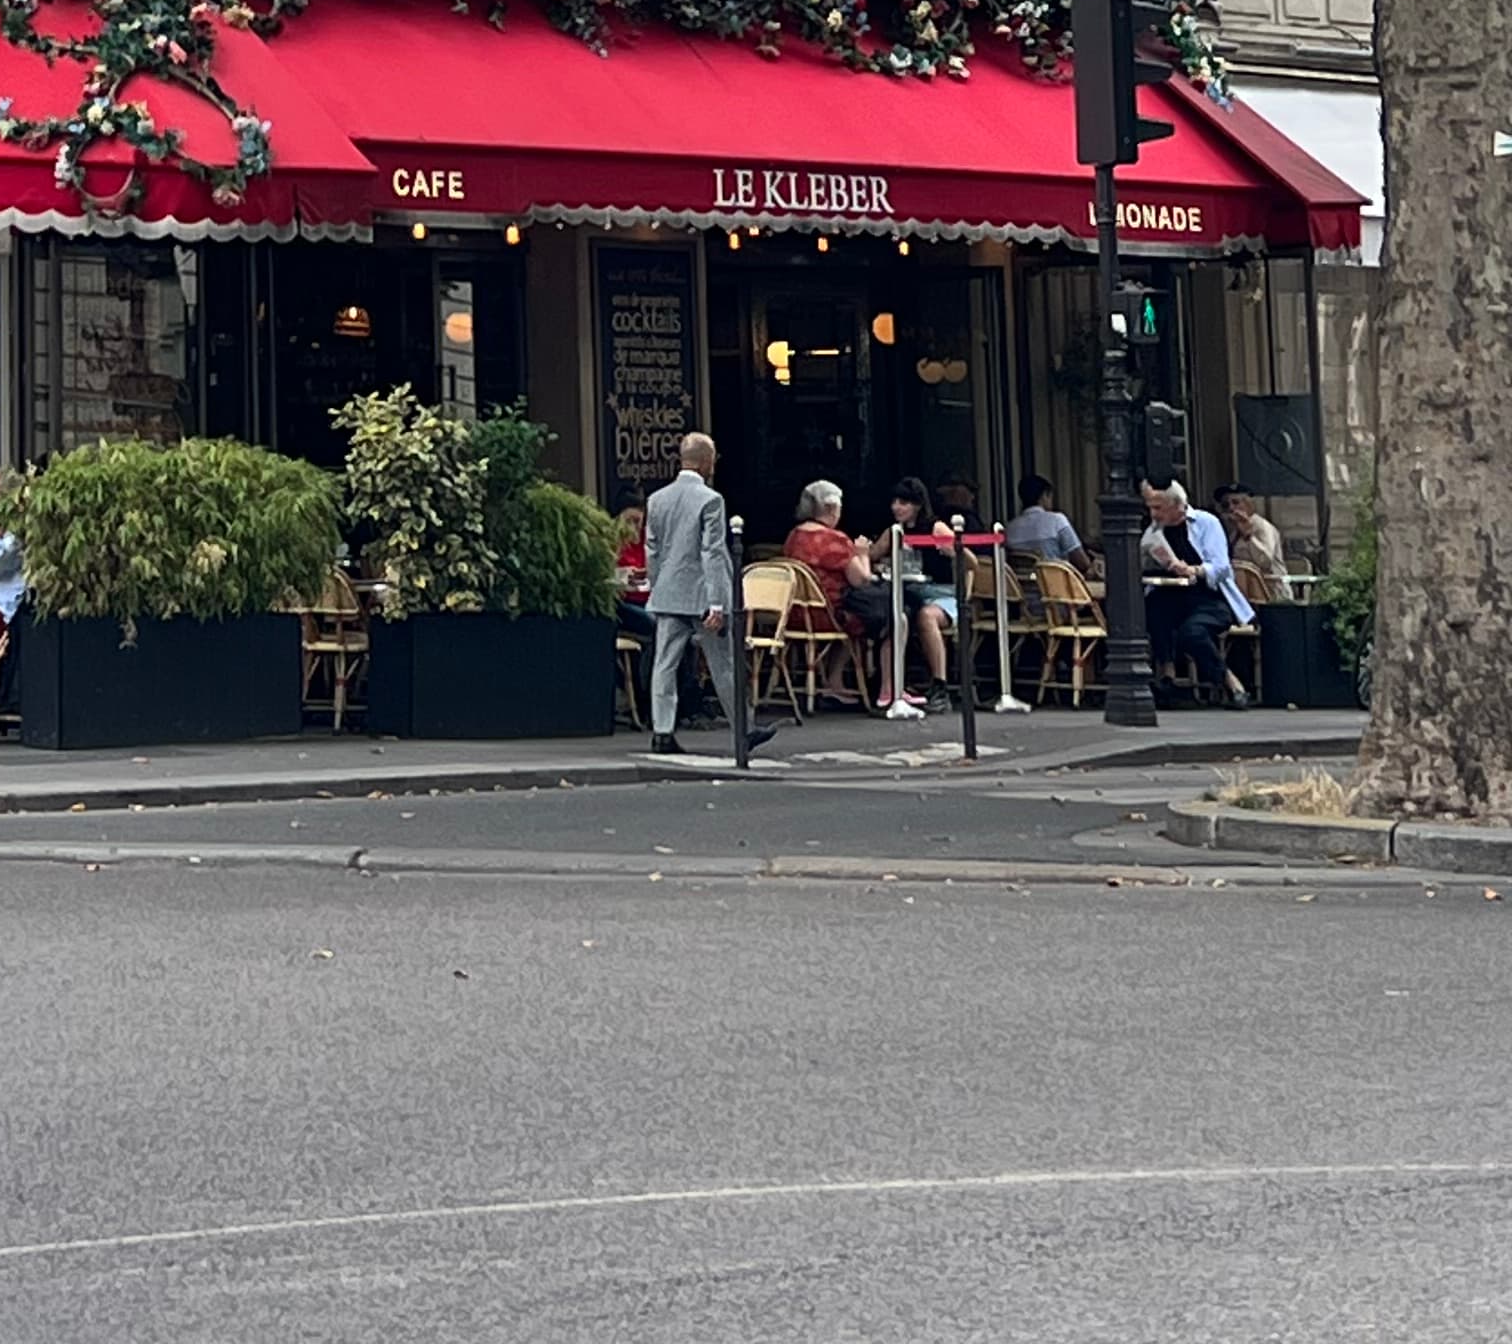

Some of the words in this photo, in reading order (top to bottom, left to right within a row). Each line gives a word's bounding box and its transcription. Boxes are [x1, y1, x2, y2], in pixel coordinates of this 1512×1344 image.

[393, 168, 464, 200] CAFE
[713, 169, 756, 207] LE
[762, 170, 894, 213] KLEBER
[612, 304, 682, 333] cocktails
[615, 397, 686, 429] whiskies
